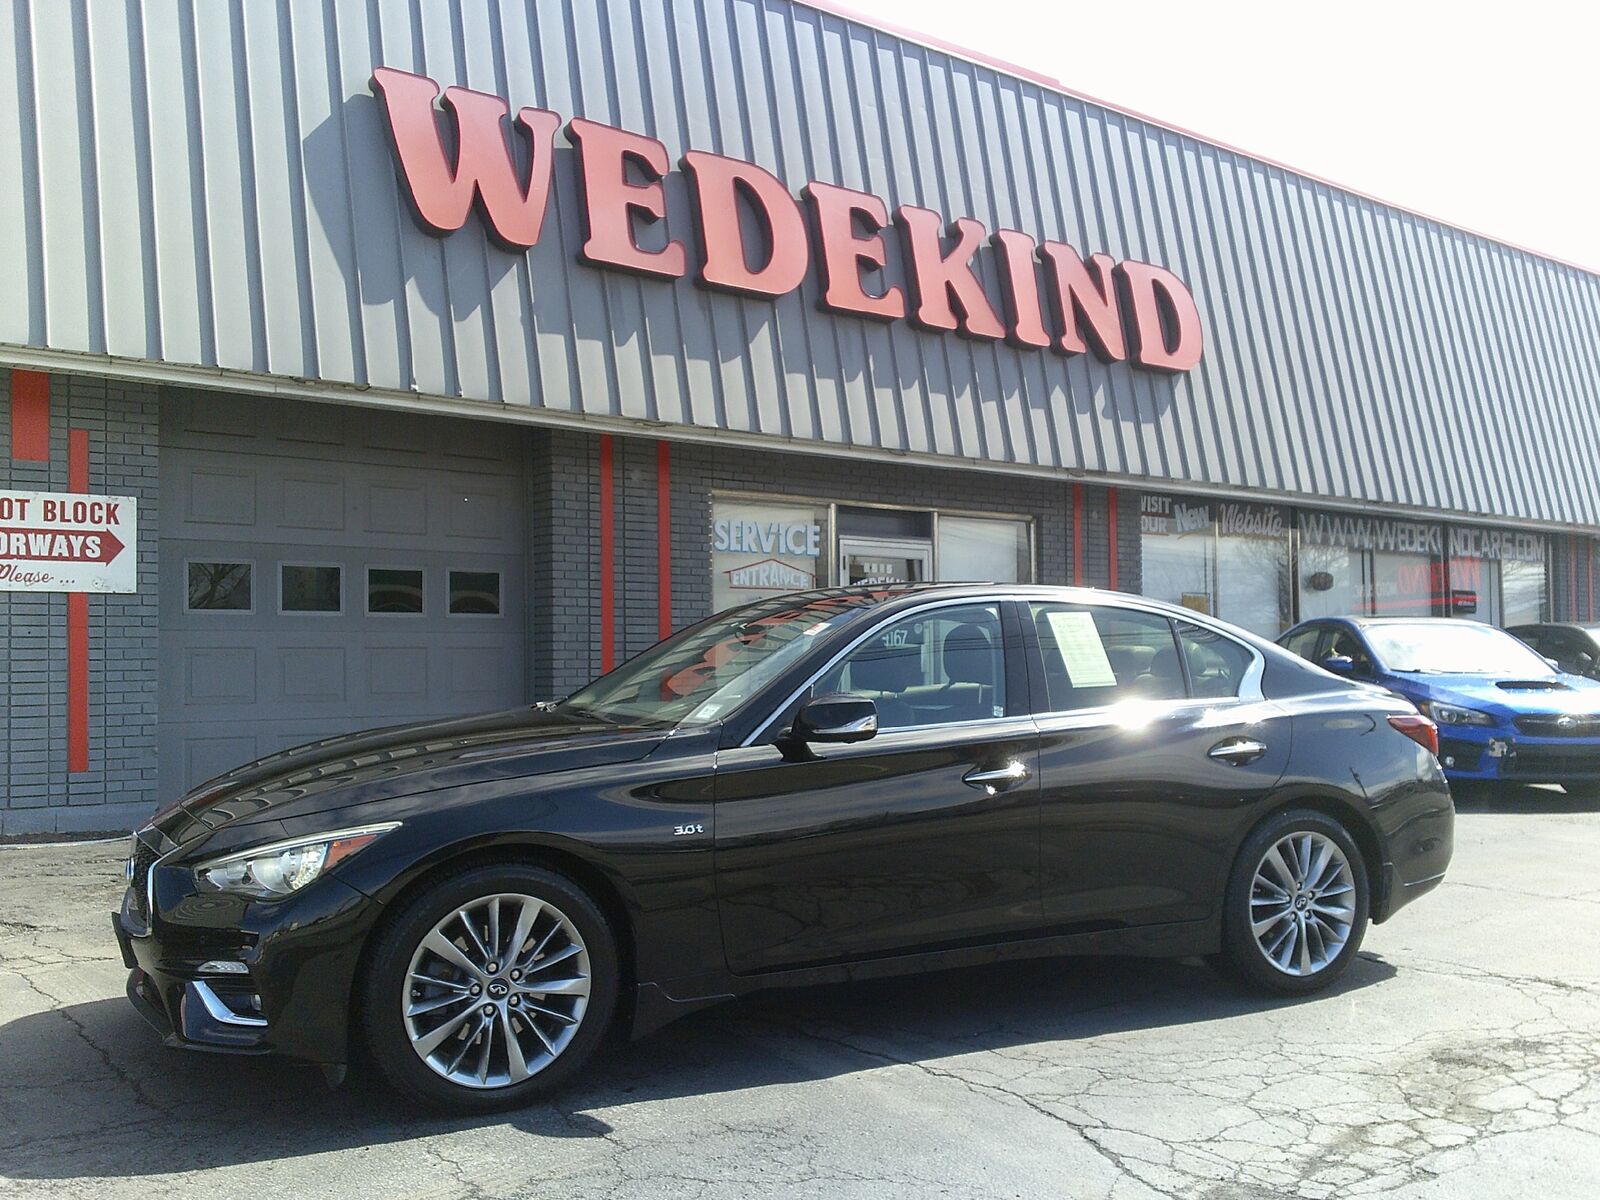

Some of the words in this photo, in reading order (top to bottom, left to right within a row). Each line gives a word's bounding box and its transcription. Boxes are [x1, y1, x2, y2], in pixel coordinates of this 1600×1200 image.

[370, 66, 1203, 374] WEDEKIND
[43, 499, 120, 525] BLOCK
[1141, 495, 1172, 514] VISIT
[1174, 503, 1210, 532] New
[1220, 503, 1282, 537] Website
[733, 564, 809, 588] ENTRANCE
[674, 824, 704, 836] 3.0t
